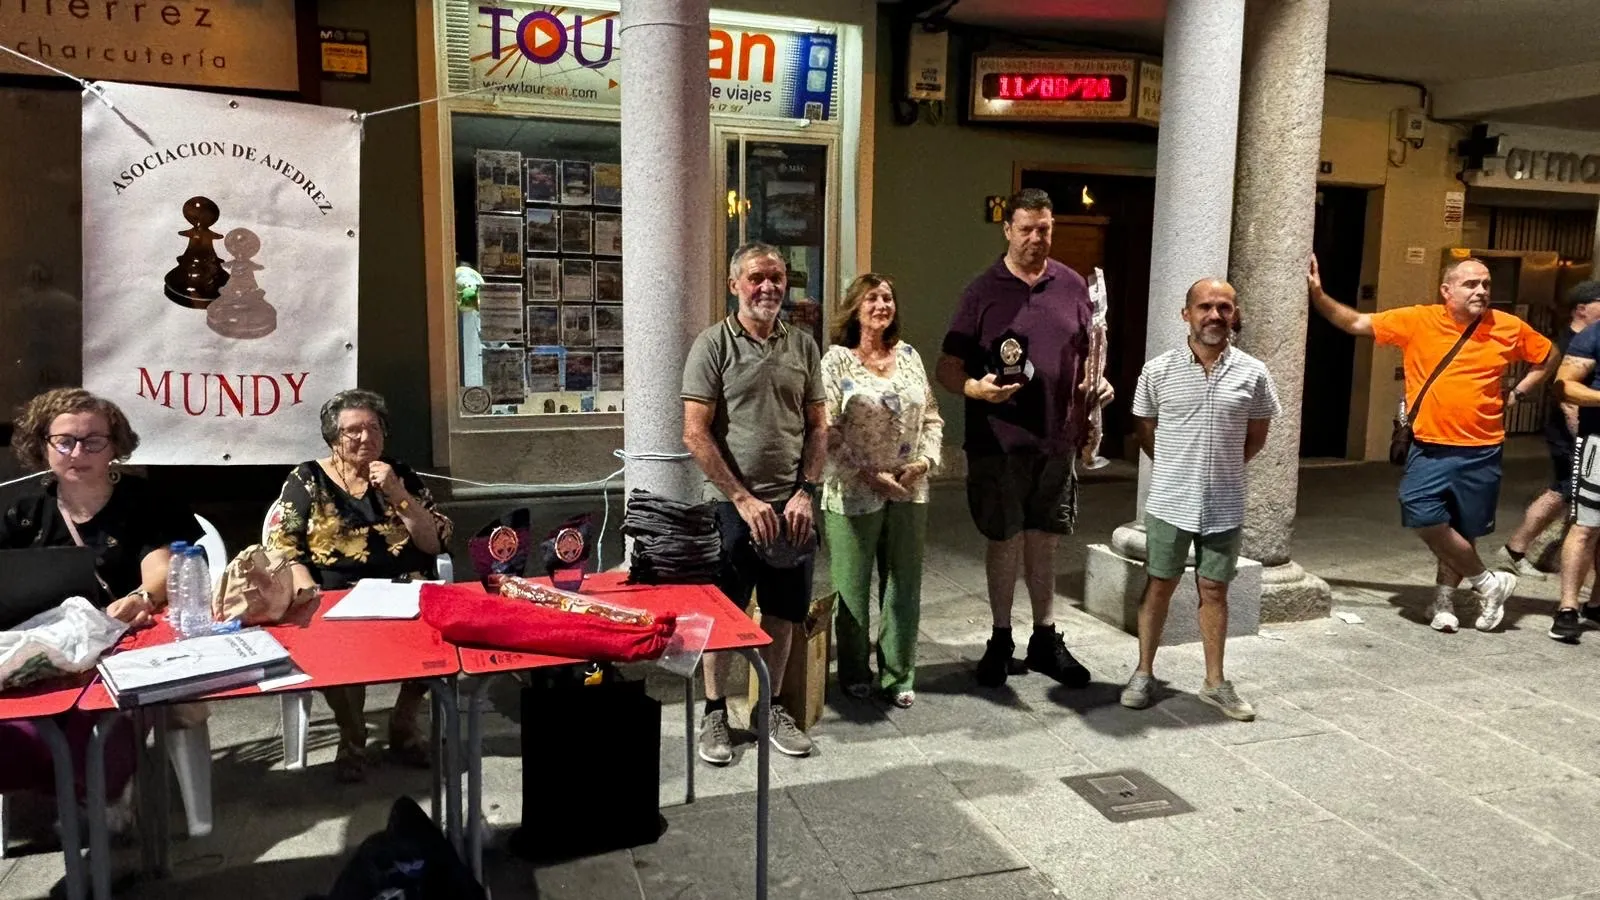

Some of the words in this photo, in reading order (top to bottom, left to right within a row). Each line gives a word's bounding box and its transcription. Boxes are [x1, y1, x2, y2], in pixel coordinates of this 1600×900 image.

[483, 80, 598, 99] www.toursan.com
[711, 87, 721, 99] e
[727, 84, 772, 105] viajes
[111, 141, 226, 195] ASOCIACION
[231, 144, 257, 162] DE
[260, 154, 335, 217] AJEDREZ
[136, 366, 310, 418] MUNDY
